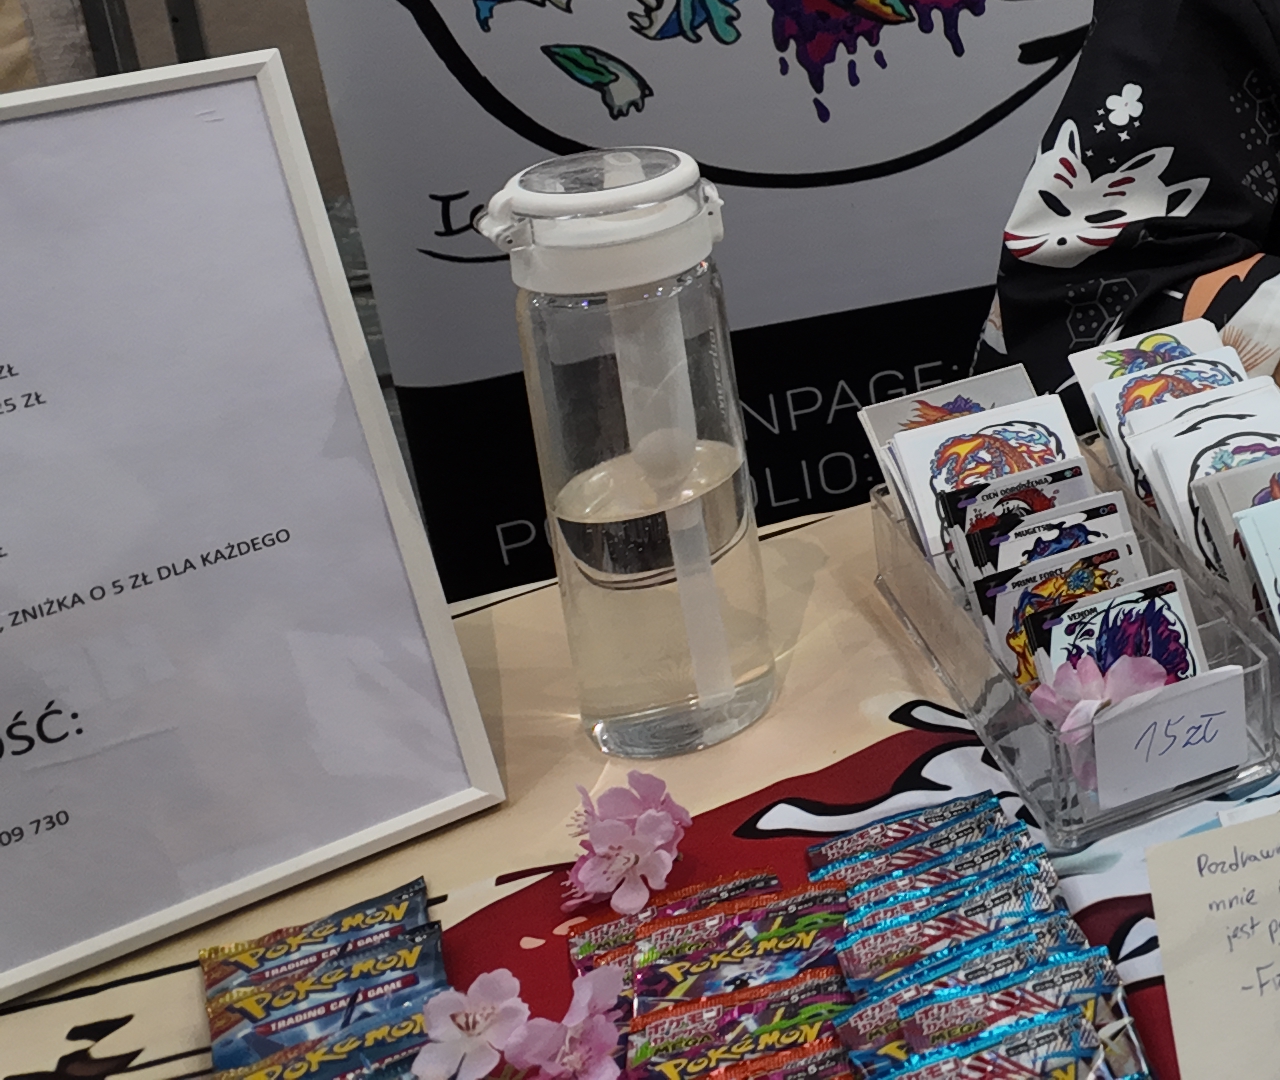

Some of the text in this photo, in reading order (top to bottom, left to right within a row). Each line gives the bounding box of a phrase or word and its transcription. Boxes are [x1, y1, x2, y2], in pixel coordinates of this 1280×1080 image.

[21, 391, 47, 408] ZŁ
[8, 528, 291, 627] ZNIŻKA O 5 ZŁ DLA KAŻDEGO
[1011, 576, 1038, 590] PRIME
[1066, 606, 1098, 622] VENOM
[0, 699, 84, 758] ŚĆ:
[29, 809, 70, 835] 730
[1208, 886, 1258, 913] mnie
[1225, 916, 1261, 953] jest
[264, 930, 391, 978] TRADING CAD GAME
[269, 980, 402, 1032] TRADING CAD GAME
